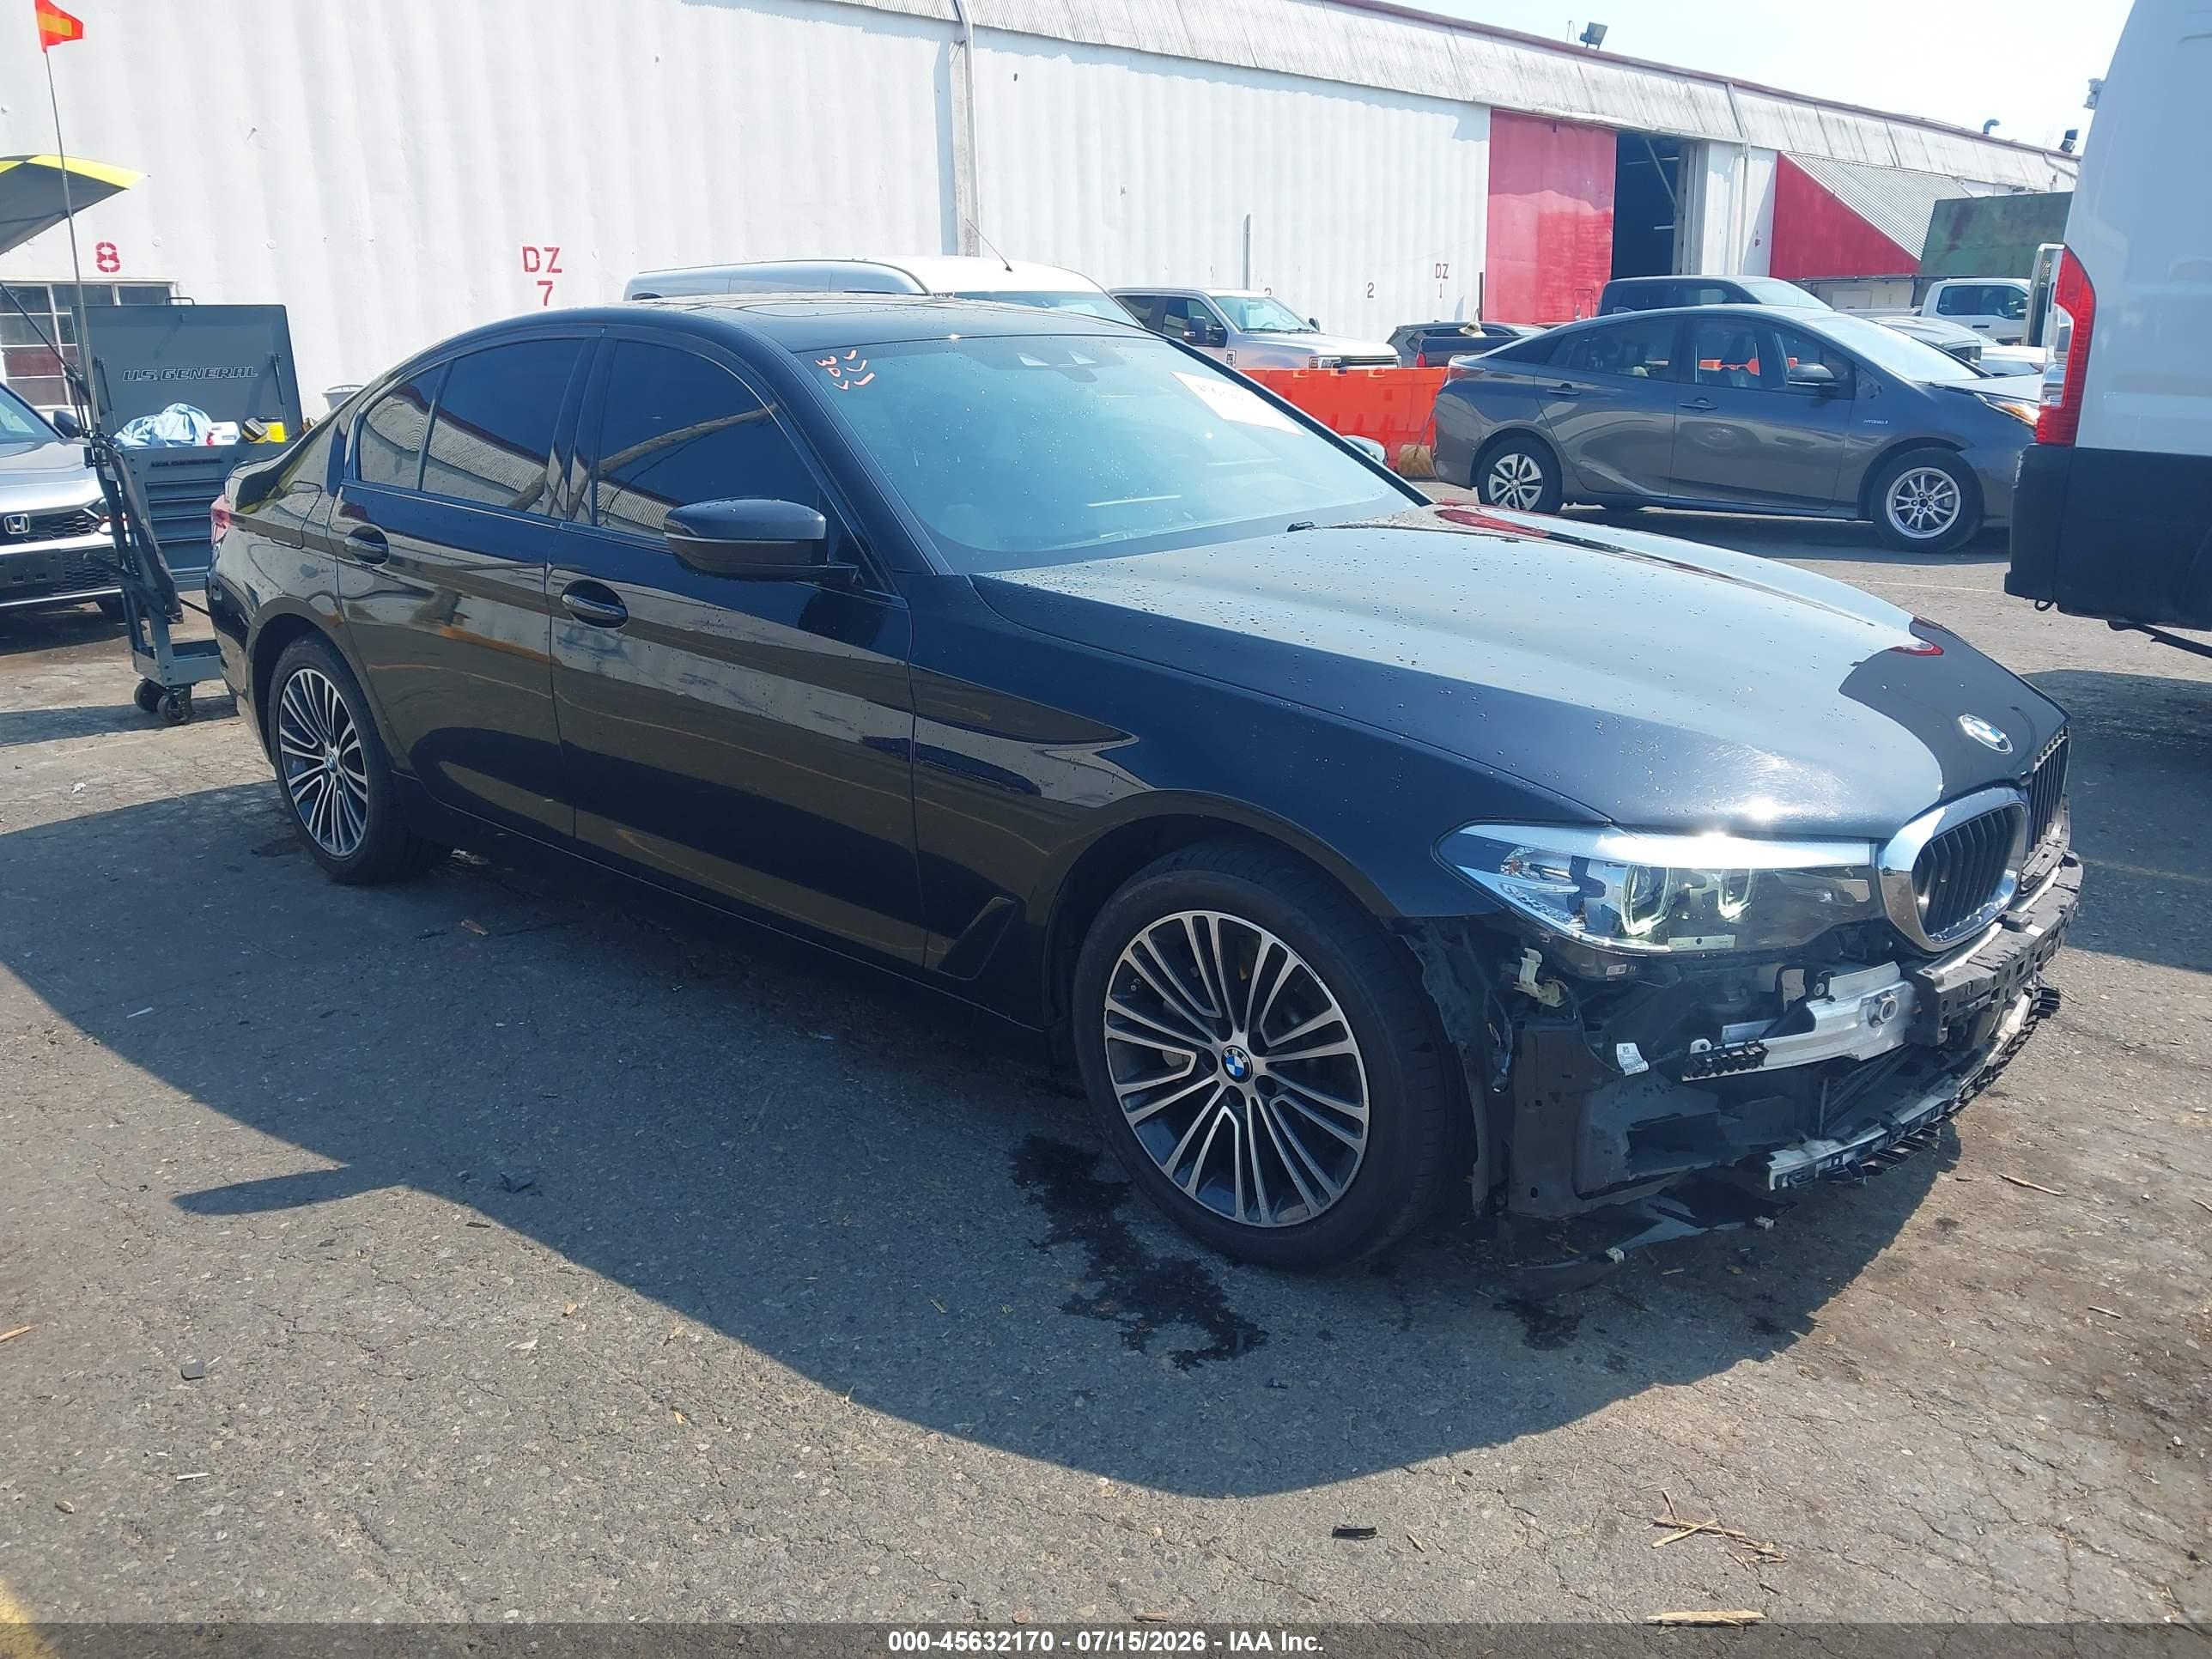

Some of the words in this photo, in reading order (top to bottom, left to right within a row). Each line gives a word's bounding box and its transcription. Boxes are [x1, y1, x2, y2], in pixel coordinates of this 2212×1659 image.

[95, 241, 120, 273] 8
[522, 246, 562, 273] DZ
[1435, 263, 1449, 279] DZ
[537, 280, 553, 307] 7
[1367, 282, 1375, 298] 2
[161, 366, 258, 380] GENERAL
